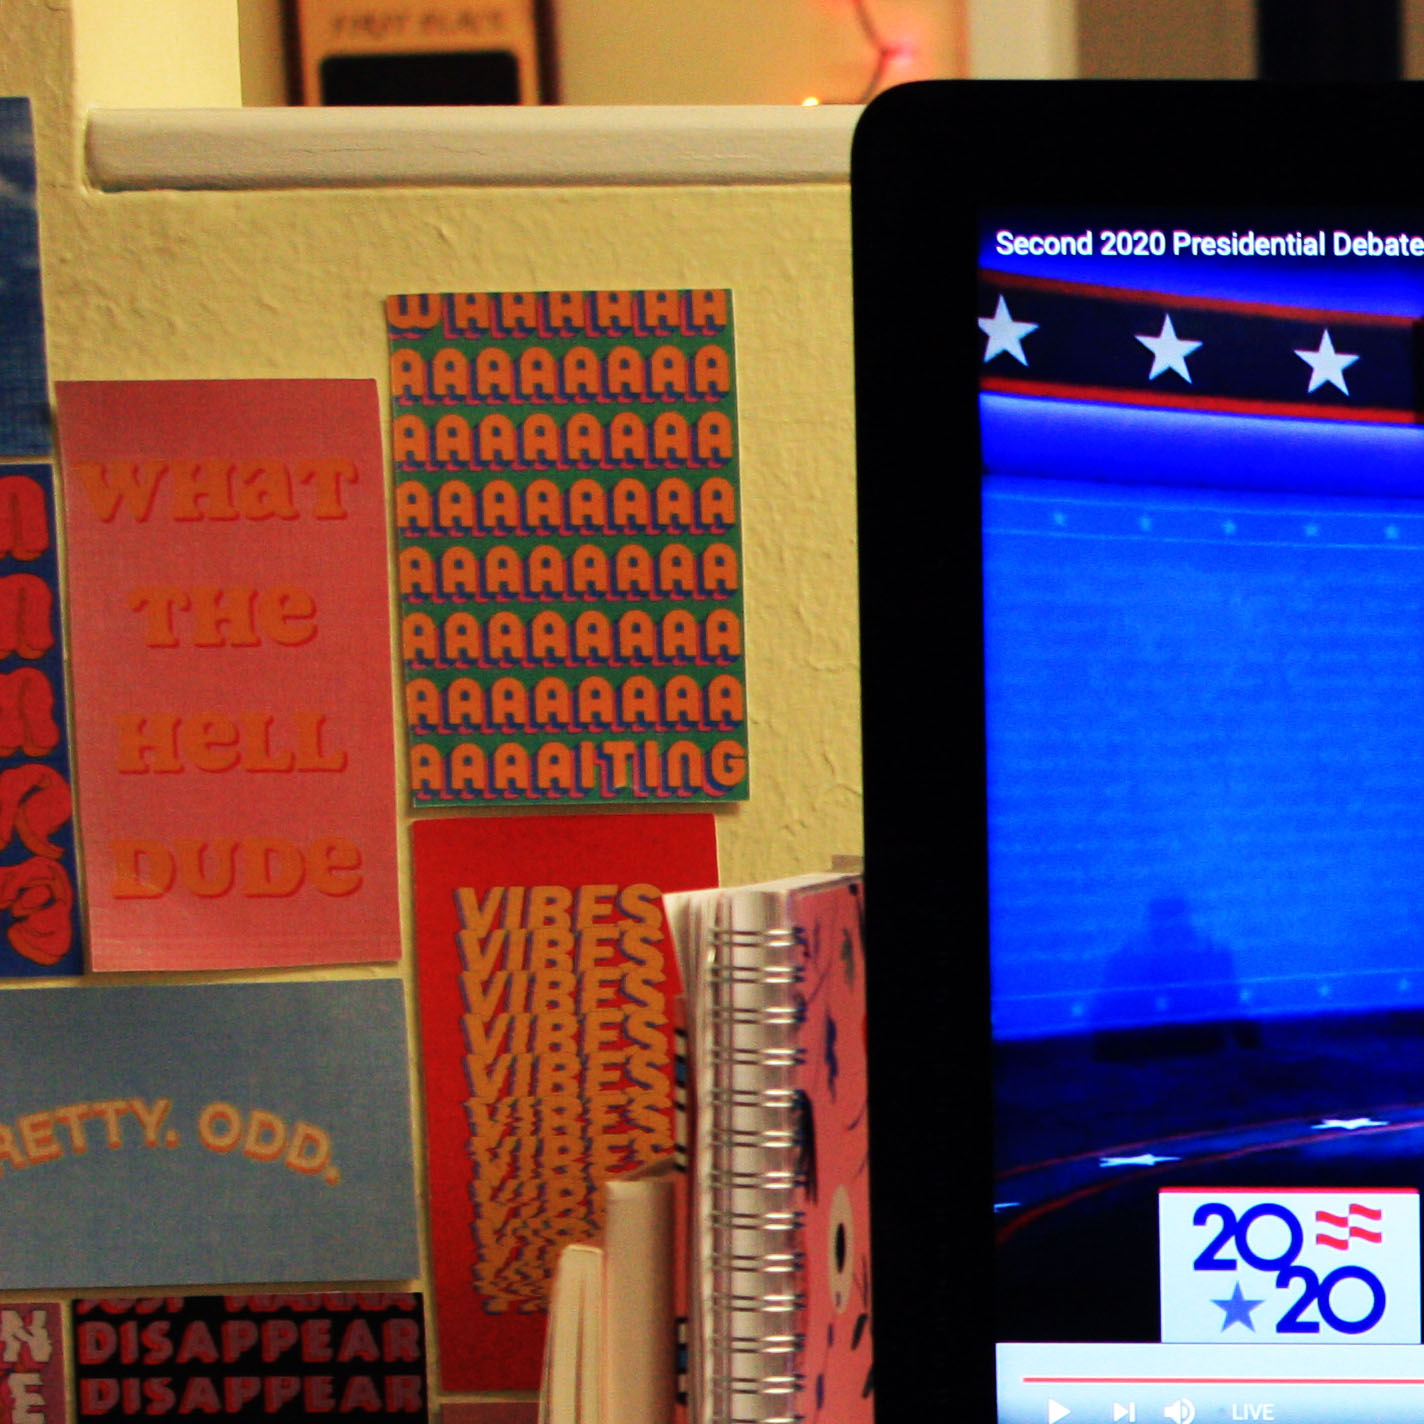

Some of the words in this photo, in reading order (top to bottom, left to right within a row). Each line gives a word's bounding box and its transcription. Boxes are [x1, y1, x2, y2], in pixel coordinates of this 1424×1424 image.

[996, 230, 1094, 258] Second
[1100, 230, 1166, 257] 2020
[1173, 230, 1326, 257] Presidential
[390, 345, 729, 405] AAAAAAAA
[393, 411, 732, 472] AAAAAAAA
[397, 477, 735, 537] AAAAAAAA
[401, 543, 738, 603] AAAAAAAA
[403, 609, 742, 670] AAAAAAAA
[405, 674, 744, 735] AAAAAAAA
[455, 883, 664, 937] VIBES
[455, 924, 664, 978] VIBES
[1193, 1203, 1303, 1271] 20
[1276, 1265, 1386, 1334] 20
[77, 1319, 420, 1365] DISAPPEAR
[80, 1375, 422, 1415] DISAPPEAR
[1232, 1403, 1274, 1421] LIVE
